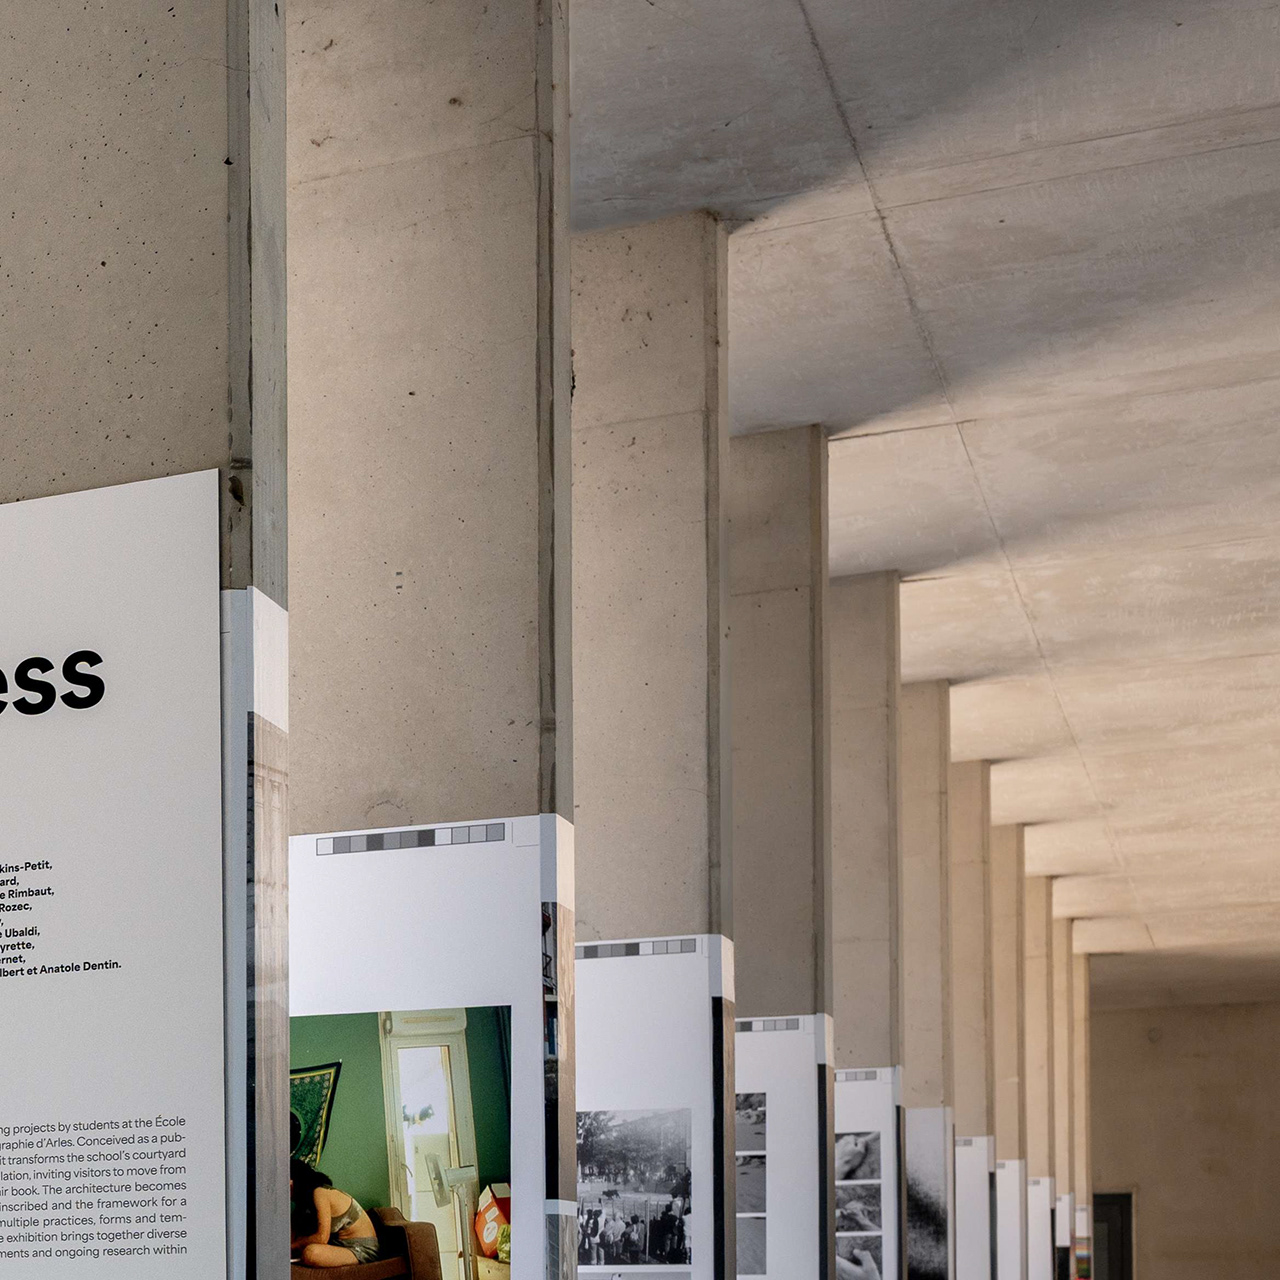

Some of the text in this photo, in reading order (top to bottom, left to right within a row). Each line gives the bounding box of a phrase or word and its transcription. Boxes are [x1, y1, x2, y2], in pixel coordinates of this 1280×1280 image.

[7, 886, 55, 899] Rimbaut,
[4, 925, 41, 939] Ubaldi,
[26, 966, 38, 976] et
[39, 962, 81, 975] Anatole
[82, 959, 122, 971] Dentin.
[12, 1122, 57, 1136] projects
[58, 1121, 72, 1134] by
[72, 1120, 120, 1132] students
[121, 1119, 133, 1129] at
[134, 1117, 153, 1129] the
[155, 1114, 186, 1128] École
